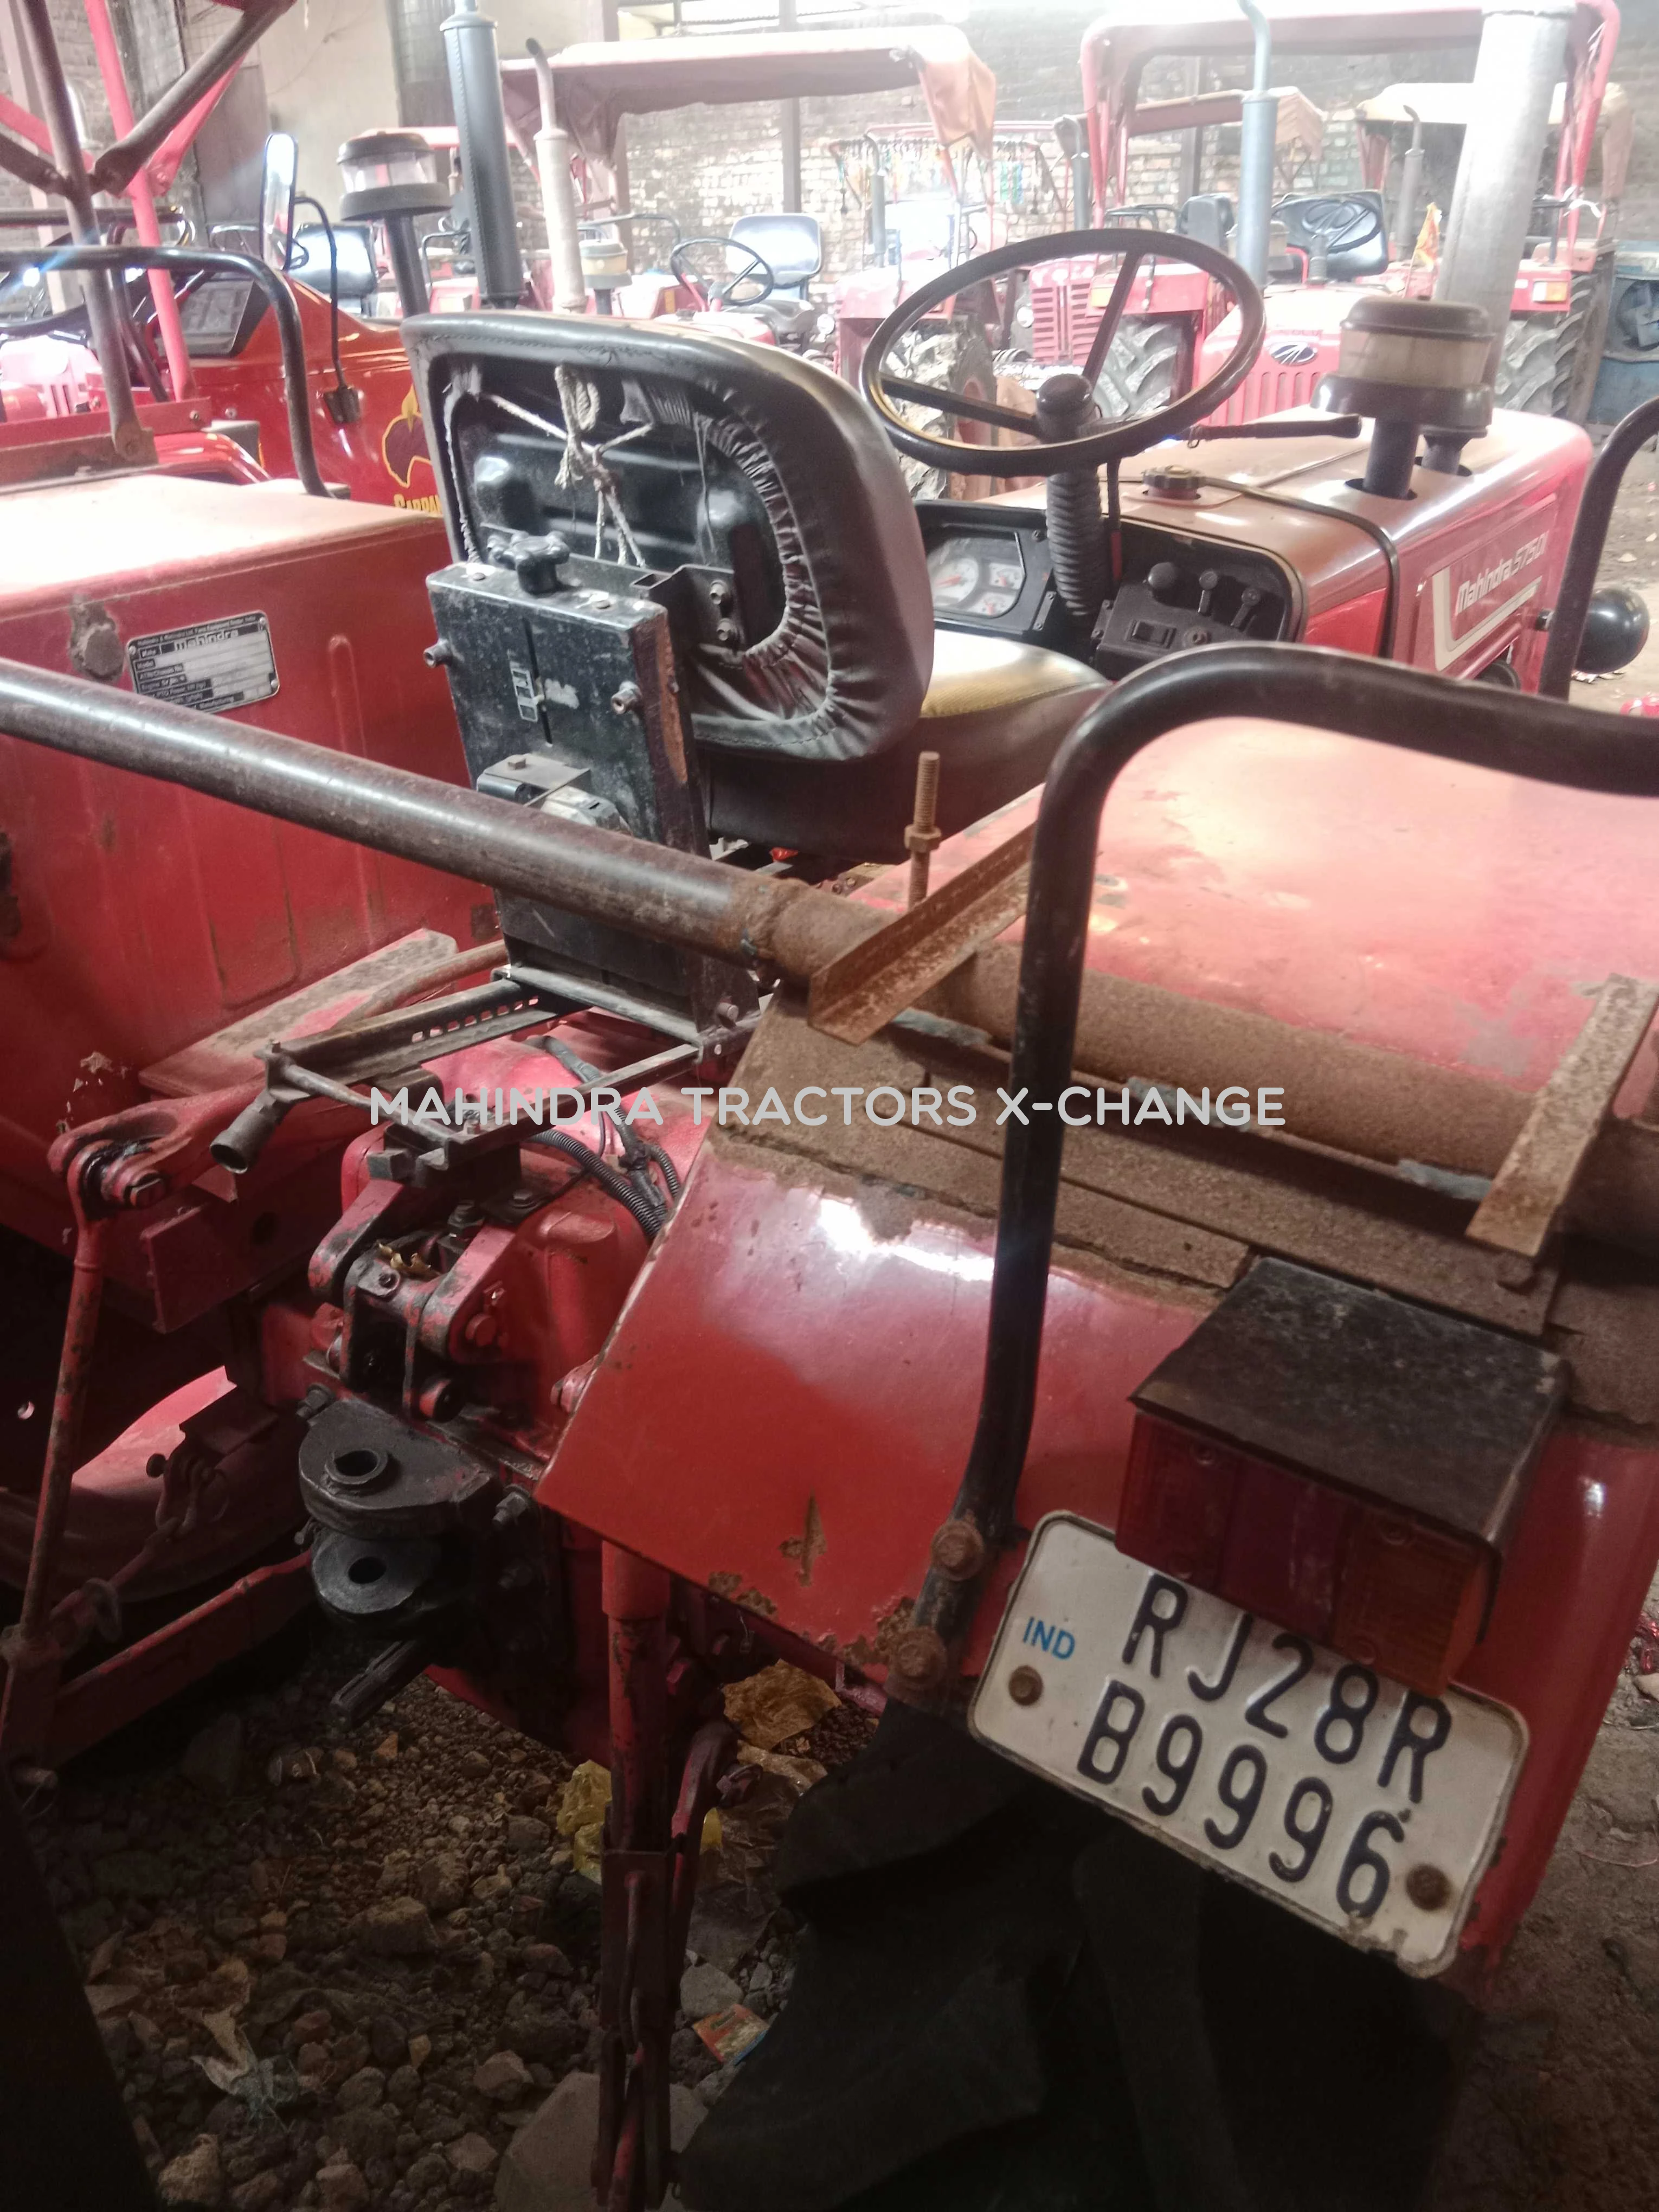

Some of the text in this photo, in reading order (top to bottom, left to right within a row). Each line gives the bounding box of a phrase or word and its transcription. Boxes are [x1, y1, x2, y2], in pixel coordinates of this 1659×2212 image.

[1455, 558, 1513, 616] Mahindra
[1023, 1616, 1076, 1659] IND
[1121, 1572, 1452, 1804] RJ28R
[1077, 1679, 1405, 1918] B9996
